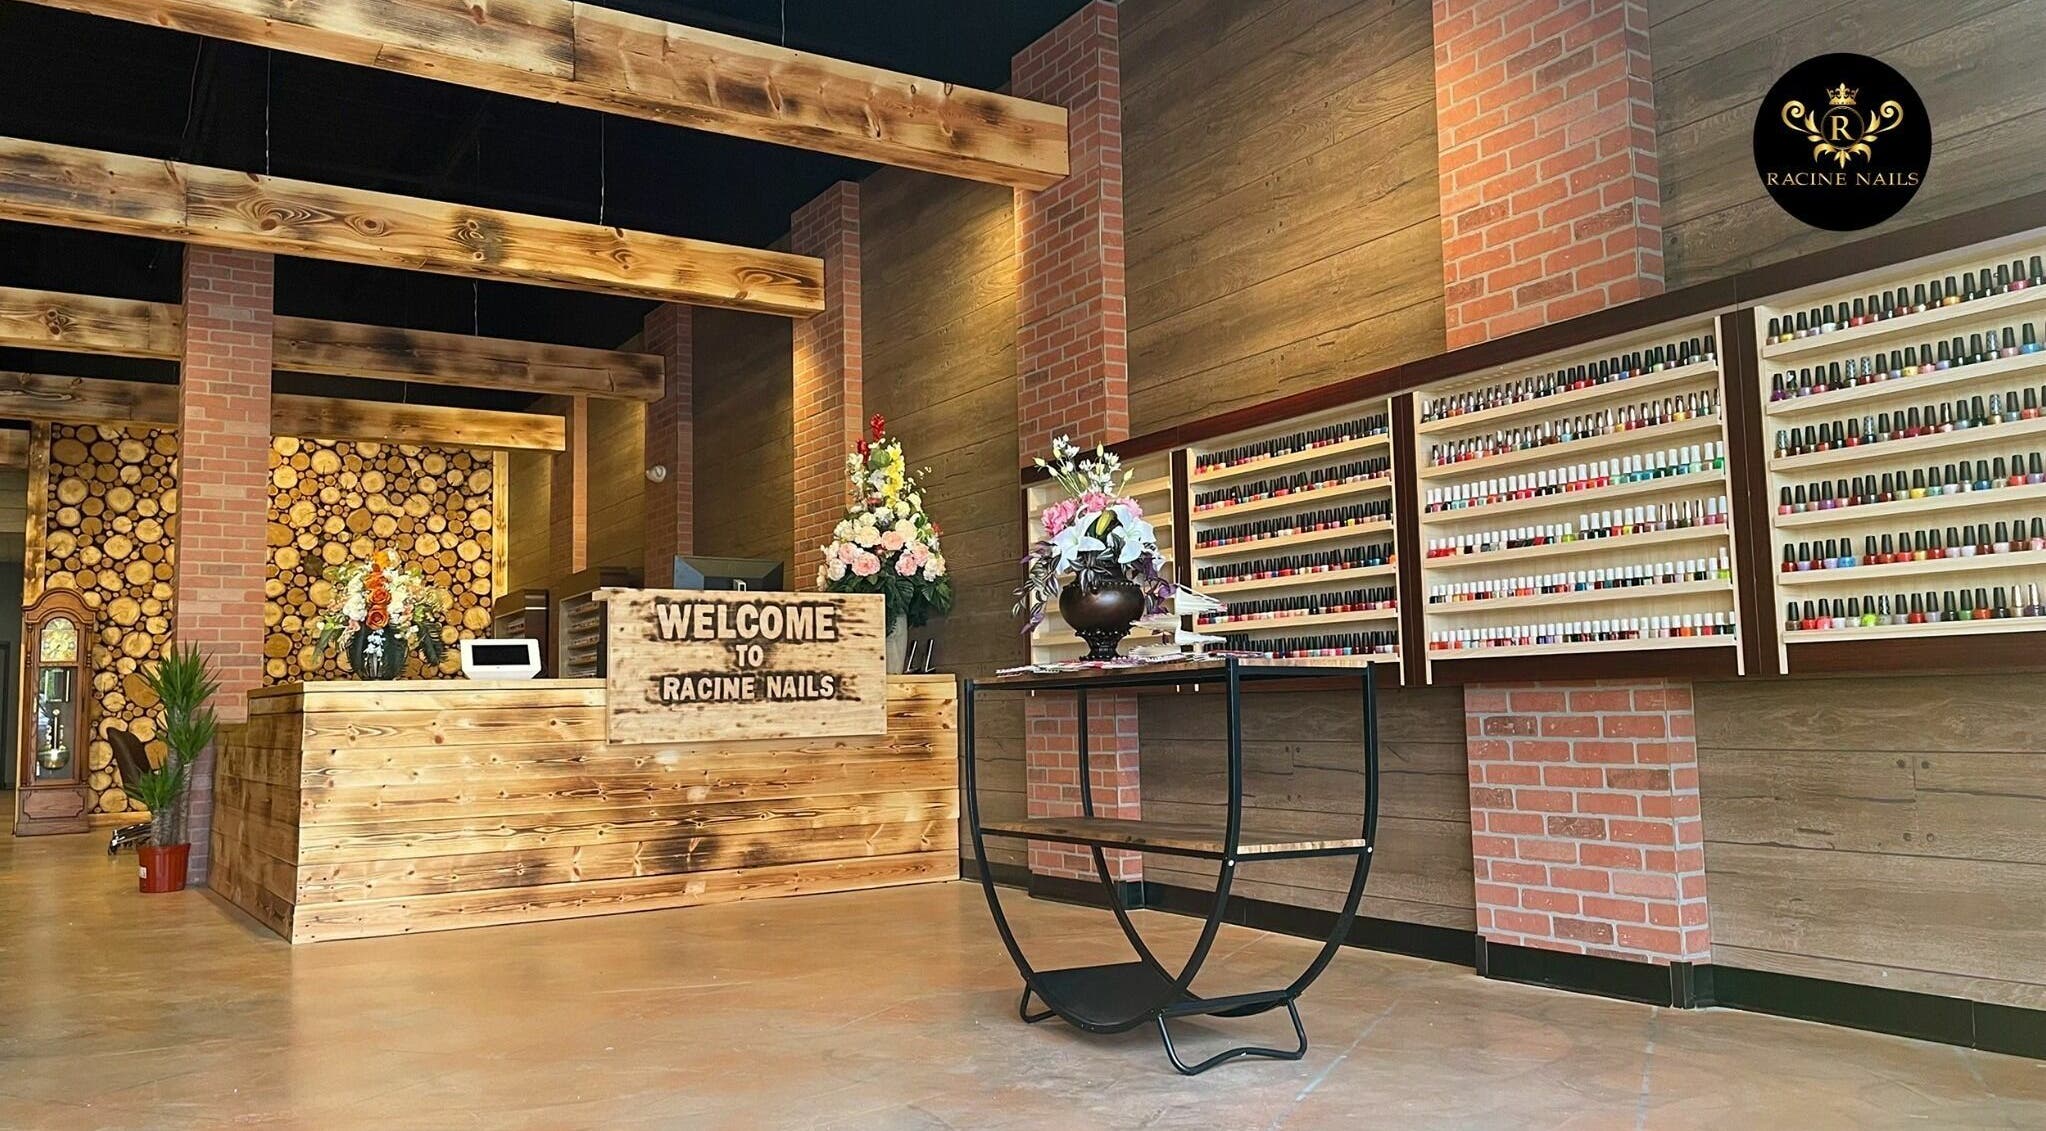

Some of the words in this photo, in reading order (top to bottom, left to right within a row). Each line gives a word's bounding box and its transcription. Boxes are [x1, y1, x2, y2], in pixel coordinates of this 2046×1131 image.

[657, 603, 836, 640] WELCOME
[735, 644, 764, 668] TO
[663, 677, 755, 701] RACINE
[766, 675, 835, 699] NAILS
